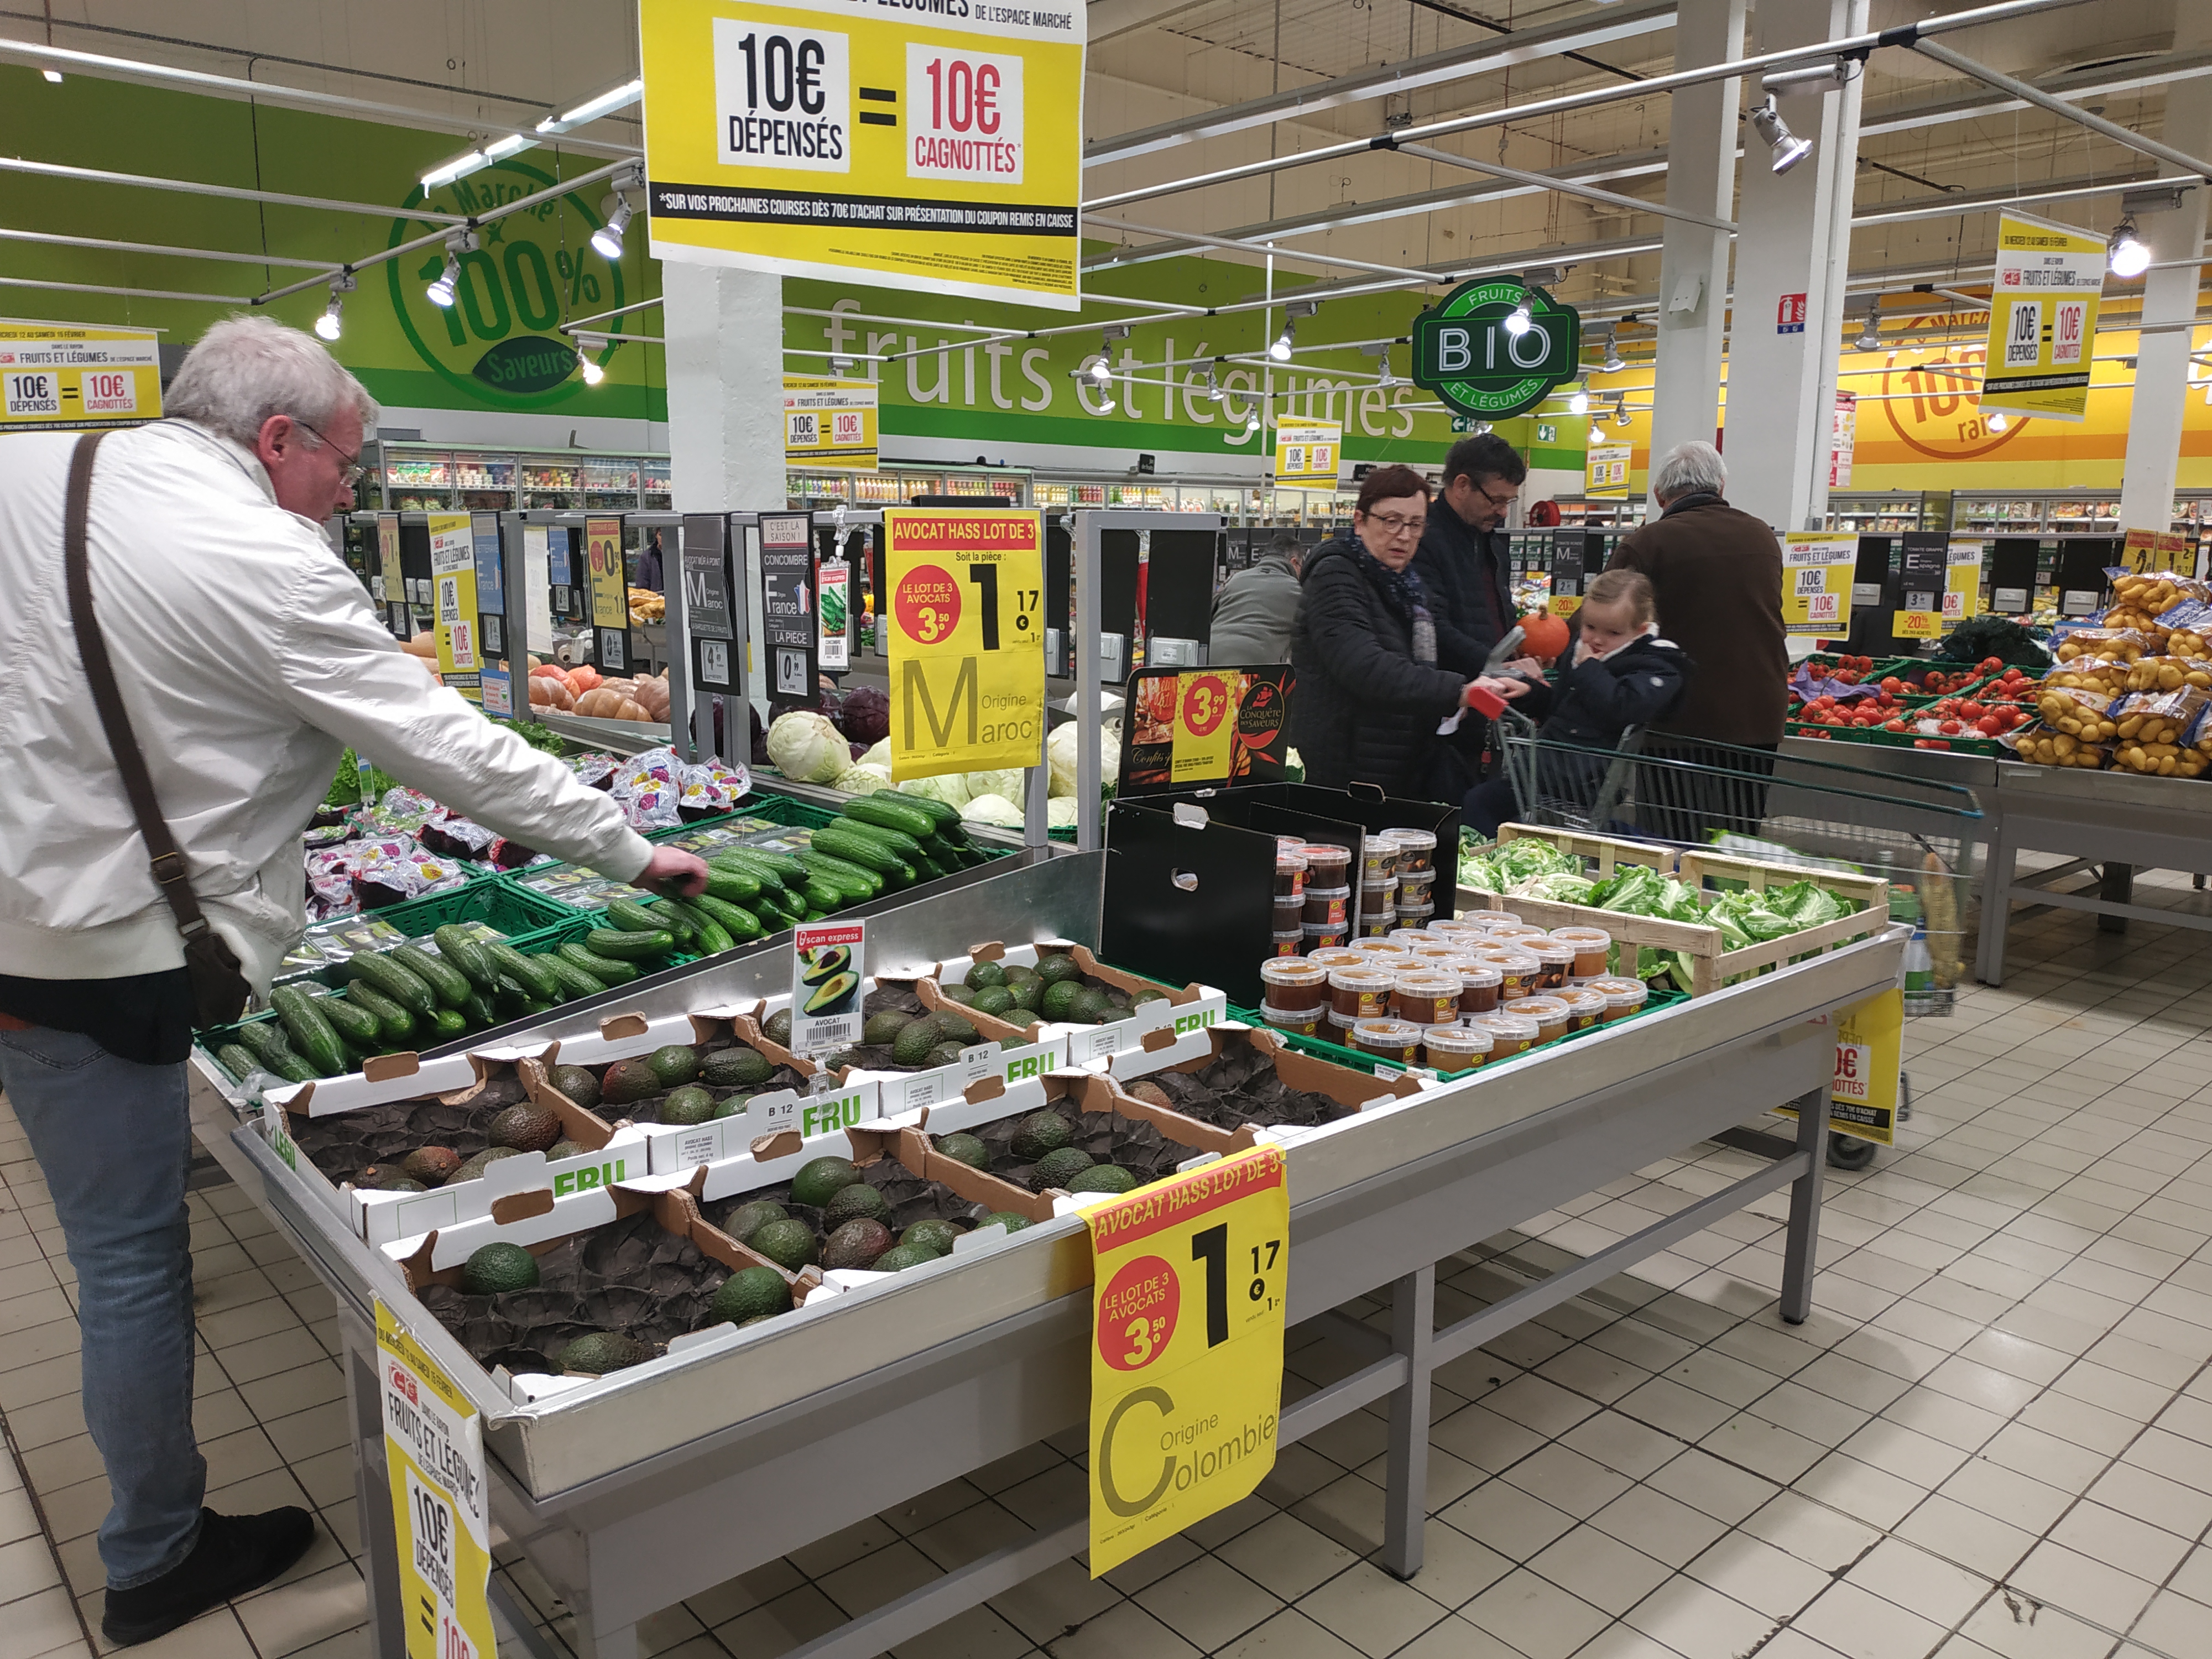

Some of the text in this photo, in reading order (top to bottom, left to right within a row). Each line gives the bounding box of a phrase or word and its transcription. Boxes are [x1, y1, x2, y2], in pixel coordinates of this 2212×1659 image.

[975, 4, 986, 20] DE
[988, 8, 1030, 25] L'ESPACE
[1032, 12, 1072, 30] MARCHÉ
[738, 33, 1001, 135] 10€ 10€
[729, 109, 843, 160] DÉPENSÉS
[688, 194, 707, 211] VOS
[709, 196, 769, 214] PROCHAINES
[770, 200, 811, 216] COURSES
[812, 199, 830, 218] DÈS
[831, 203, 849, 219] 70€
[850, 204, 885, 220] D'ACHAT
[886, 206, 903, 221] SUR
[905, 204, 963, 223] PRÉSENTATION
[965, 210, 976, 224] DU
[977, 211, 1009, 226] COUPON
[1010, 212, 1035, 227] REMIS
[1036, 213, 1046, 227] EN
[1047, 213, 1074, 228] CAISSE
[2023, 270, 2042, 285] FRUITS
[2043, 271, 2049, 285] ET
[2051, 268, 2076, 285] LÉGUMES
[1468, 289, 1521, 306] FRUITS
[2015, 306, 2081, 341] 10€ 10€
[19, 352, 53, 363] FRUITS
[54, 353, 65, 363] ET
[67, 350, 108, 363] LÉGUMES
[1439, 324, 1551, 372] BIO
[2008, 341, 2037, 362] DÉPENSÉS
[487, 348, 572, 384] Saveurs
[823, 298, 1053, 412] fruits
[1164, 338, 1414, 445] légumes
[12, 375, 124, 398] 10€ 10€
[1449, 378, 1538, 408] ET LÉGUMES
[11, 399, 56, 412] DÉPENSÉS
[87, 397, 133, 410] CAGNOTTÉS
[825, 397, 848, 406] LÉGUMES
[793, 415, 857, 433] 10€ 10€
[790, 434, 817, 443] DÉPENSÉS
[1290, 448, 1302, 462] 10€
[770, 521, 800, 531] C'EST LA
[894, 523, 1034, 539] AVOCAT HASS LOT DE 3
[771, 531, 796, 541] SAISON
[451, 545, 469, 563] LÉGUMES
[764, 555, 808, 566] CONCOMBRE
[956, 552, 1001, 563] Soit la pièce
[1790, 550, 1850, 562] FRUITS ET LÉGUMES
[1802, 571, 1820, 586] 10€
[441, 580, 454, 607] 10€
[766, 576, 796, 615] France
[902, 583, 952, 593] LE LOT DE 3
[1797, 586, 1823, 594] DÉPENSÉS
[906, 594, 950, 603] AVOCATS
[969, 564, 1039, 650] 1 17
[1814, 596, 1833, 611] 10€
[1911, 594, 1917, 606] 3
[1810, 610, 1836, 618] CAGNOTTÉS
[918, 607, 949, 641] 3 50
[453, 625, 468, 651] 10€
[775, 629, 807, 644] LA PIÈCE
[708, 646, 714, 670] 4
[784, 655, 791, 680] 0
[982, 693, 1026, 711] Origine
[1191, 687, 1224, 724] 3 99
[806, 933, 859, 944] scan express
[815, 1018, 841, 1026] AVOCAT
[968, 1050, 988, 1063] B 12
[769, 1104, 792, 1117] B 12
[804, 1095, 860, 1137] FRU
[1856, 1108, 1877, 1117] D'ACHAT
[1857, 1115, 1874, 1124] CAISSE
[1097, 1153, 1279, 1239] AVOCAT HASS LOT DE 3
[1105, 1272, 1169, 1309] LE LOT DE 3
[1192, 1222, 1280, 1349] 1 17
[1109, 1288, 1165, 1322] AVOCATS
[1123, 1316, 1166, 1365] 3 50
[388, 1391, 422, 1449] FRUITS
[424, 1423, 436, 1463] ET
[1161, 1413, 1219, 1451] Origine
[1099, 1386, 1275, 1517] Colombie
[414, 1485, 447, 1565] 10€
